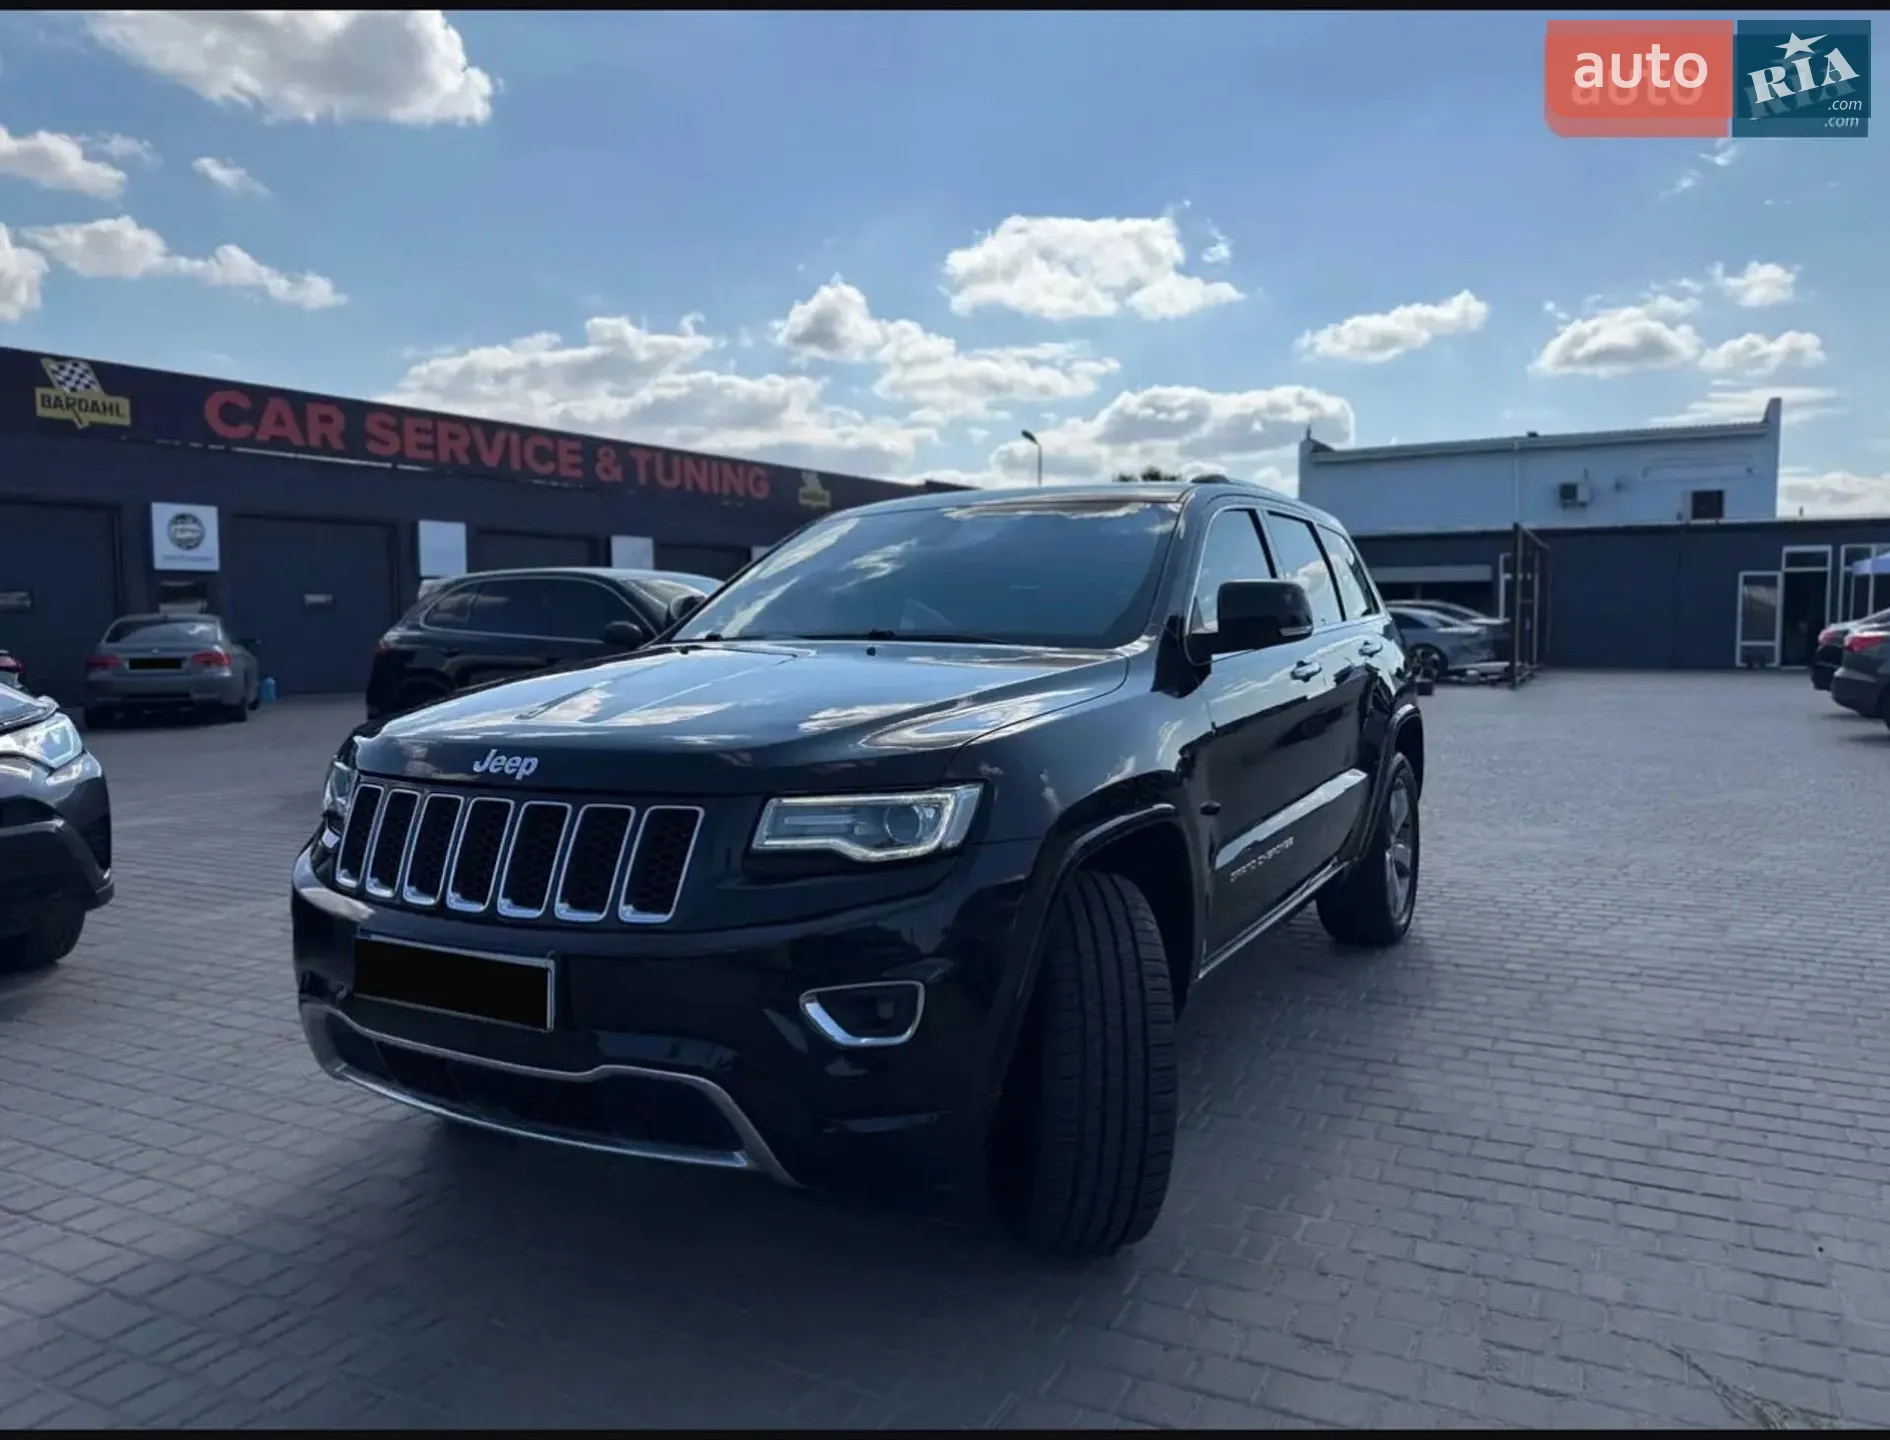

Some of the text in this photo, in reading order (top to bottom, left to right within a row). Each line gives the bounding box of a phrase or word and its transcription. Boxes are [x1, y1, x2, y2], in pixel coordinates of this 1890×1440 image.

[40, 393, 126, 418] BARDAHL
[204, 391, 769, 499] CAR SERVICE & TUNING
[473, 749, 538, 780] Jeep
